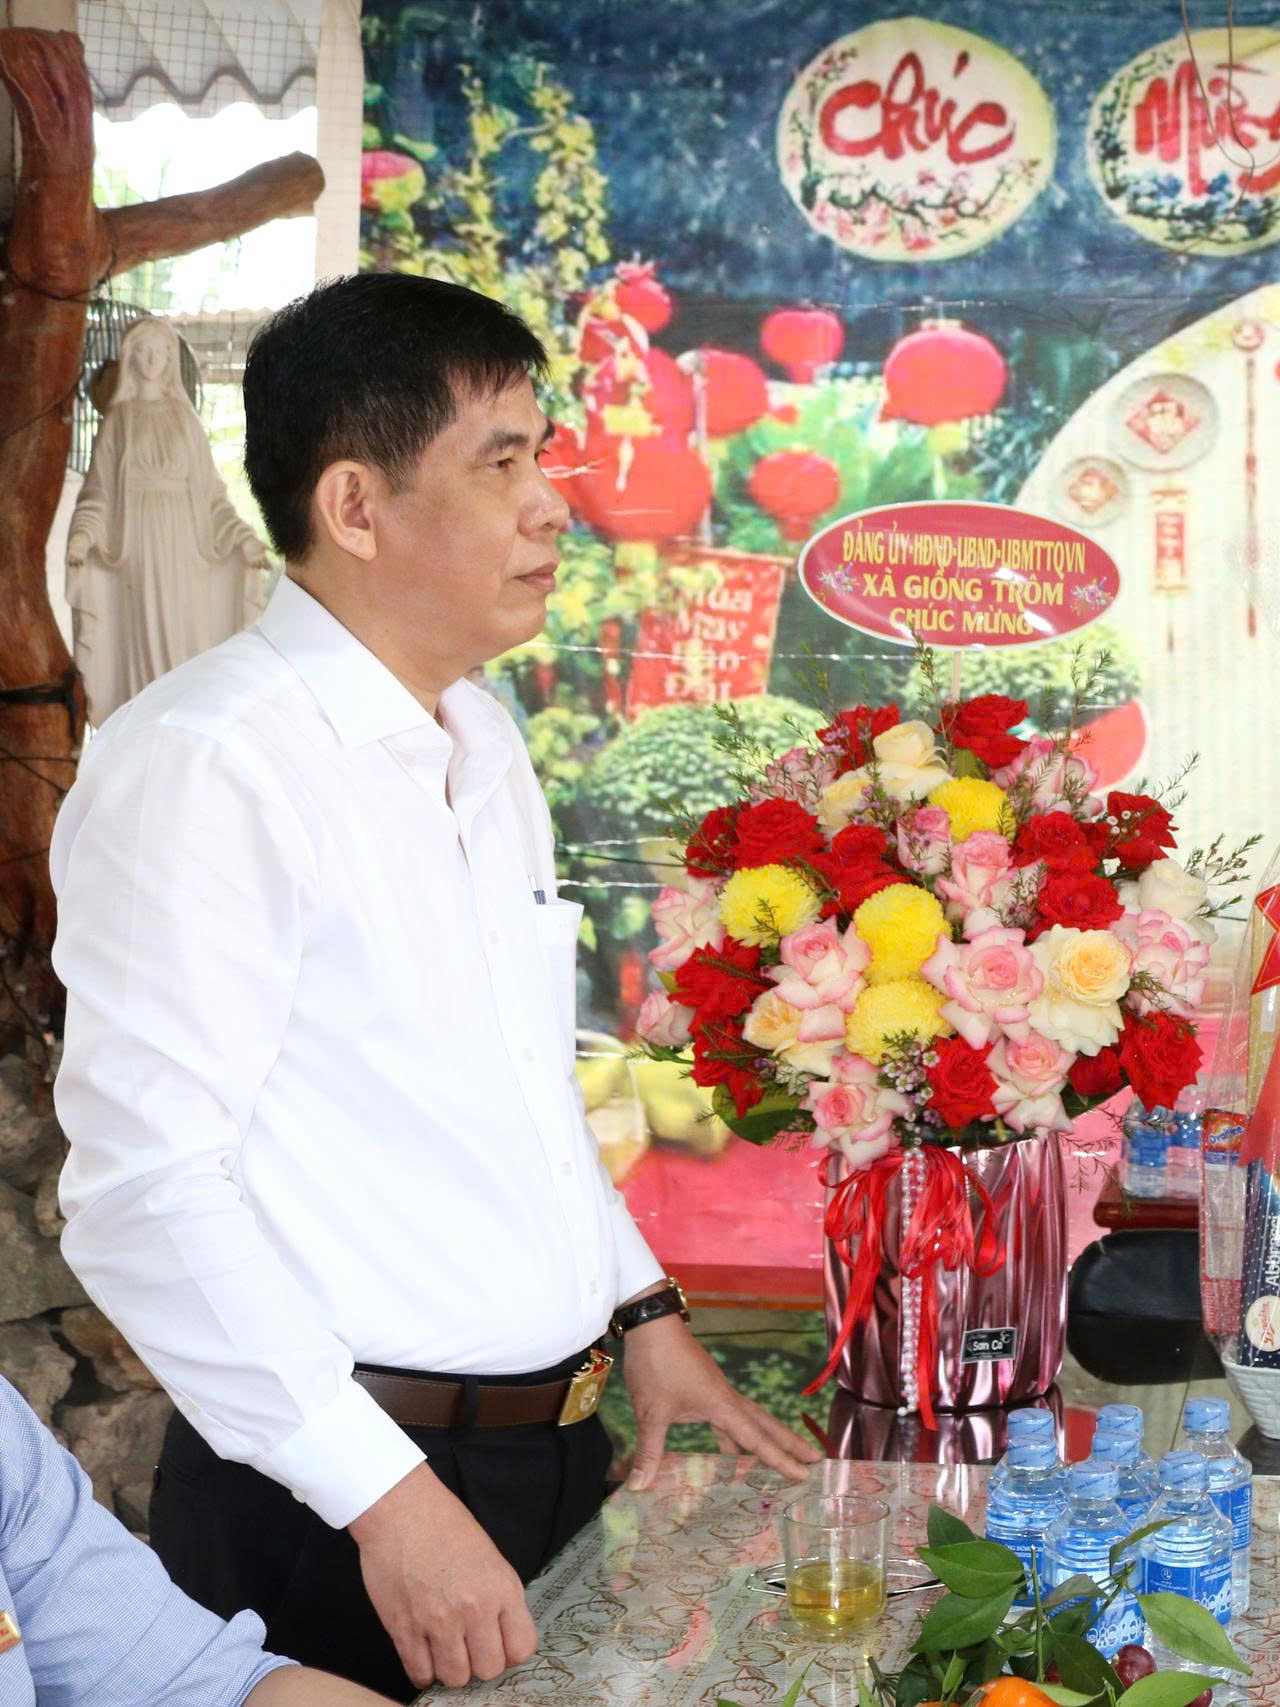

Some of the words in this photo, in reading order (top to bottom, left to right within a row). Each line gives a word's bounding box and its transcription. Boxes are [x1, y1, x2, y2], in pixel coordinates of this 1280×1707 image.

[818, 51, 1016, 164] Chúc
[842, 519, 885, 565] ĐẢNG
[888, 602, 955, 633] CHÚC
